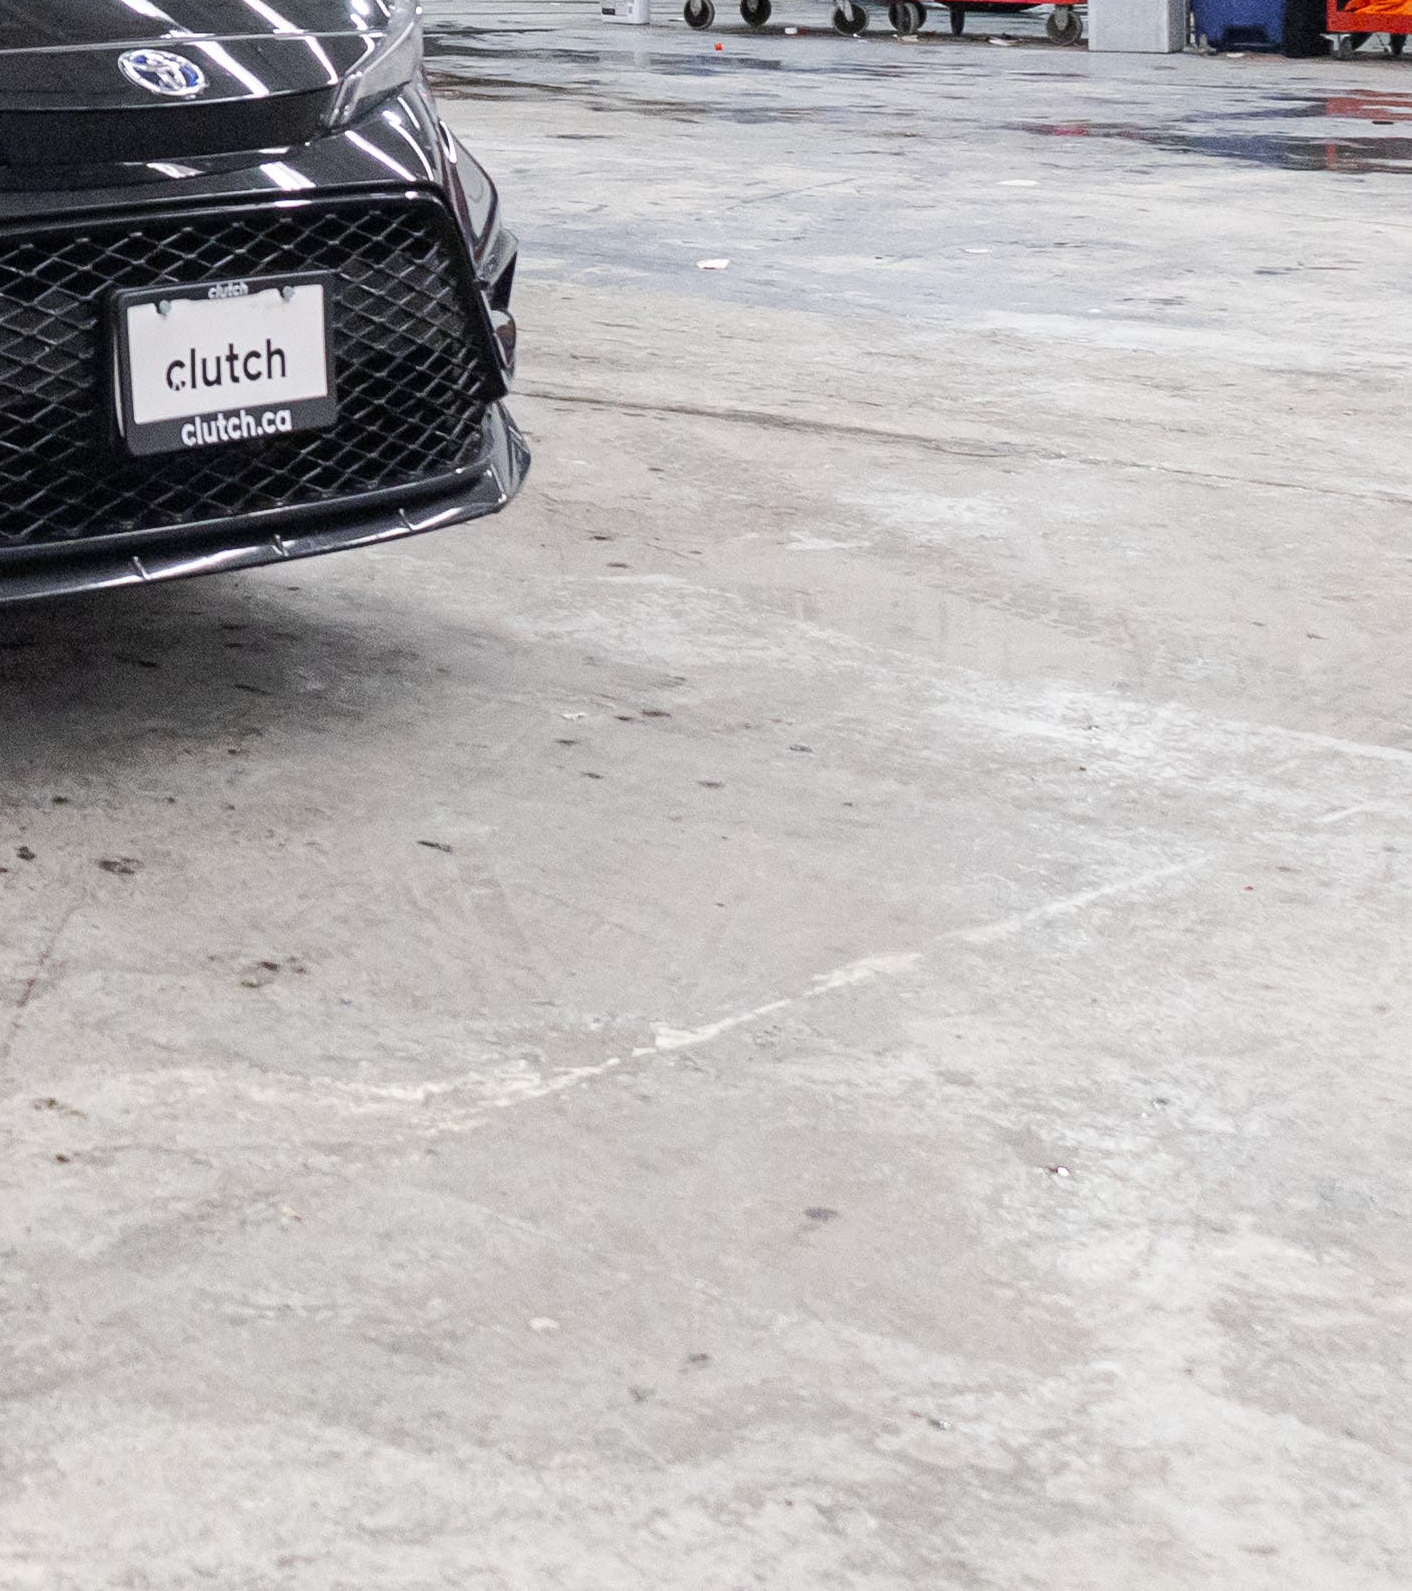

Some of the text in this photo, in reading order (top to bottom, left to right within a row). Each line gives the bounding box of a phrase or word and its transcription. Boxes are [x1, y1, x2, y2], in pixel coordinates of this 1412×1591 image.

[208, 282, 248, 299] clutch
[166, 339, 287, 391] clutch
[181, 409, 292, 446] clutch.ca
